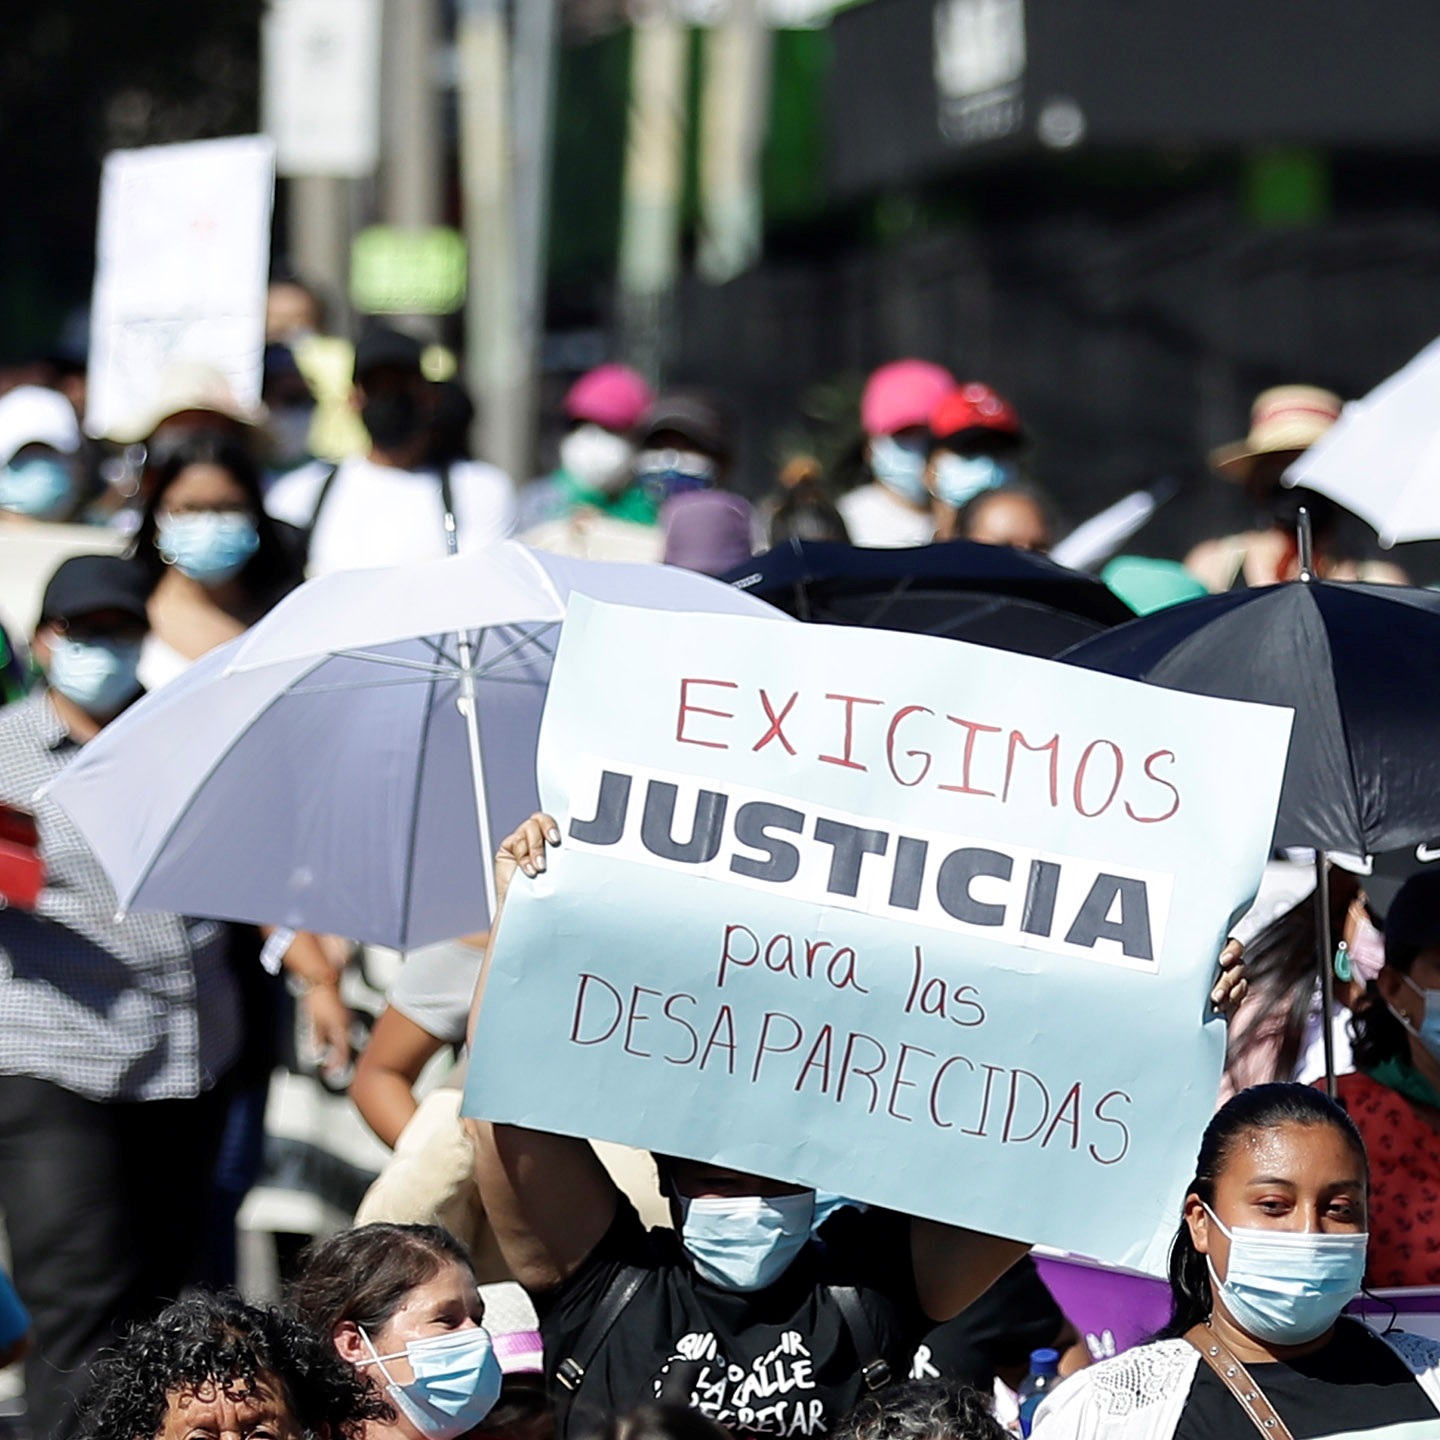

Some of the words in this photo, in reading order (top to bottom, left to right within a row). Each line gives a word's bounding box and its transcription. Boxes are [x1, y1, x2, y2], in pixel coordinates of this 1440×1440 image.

[676, 678, 1180, 823] EXIGIMOS
[568, 769, 1155, 962] JUSTICIA
[717, 924, 870, 995] para
[904, 946, 987, 1027] las
[569, 973, 1132, 1166] DESAPARECIDAS
